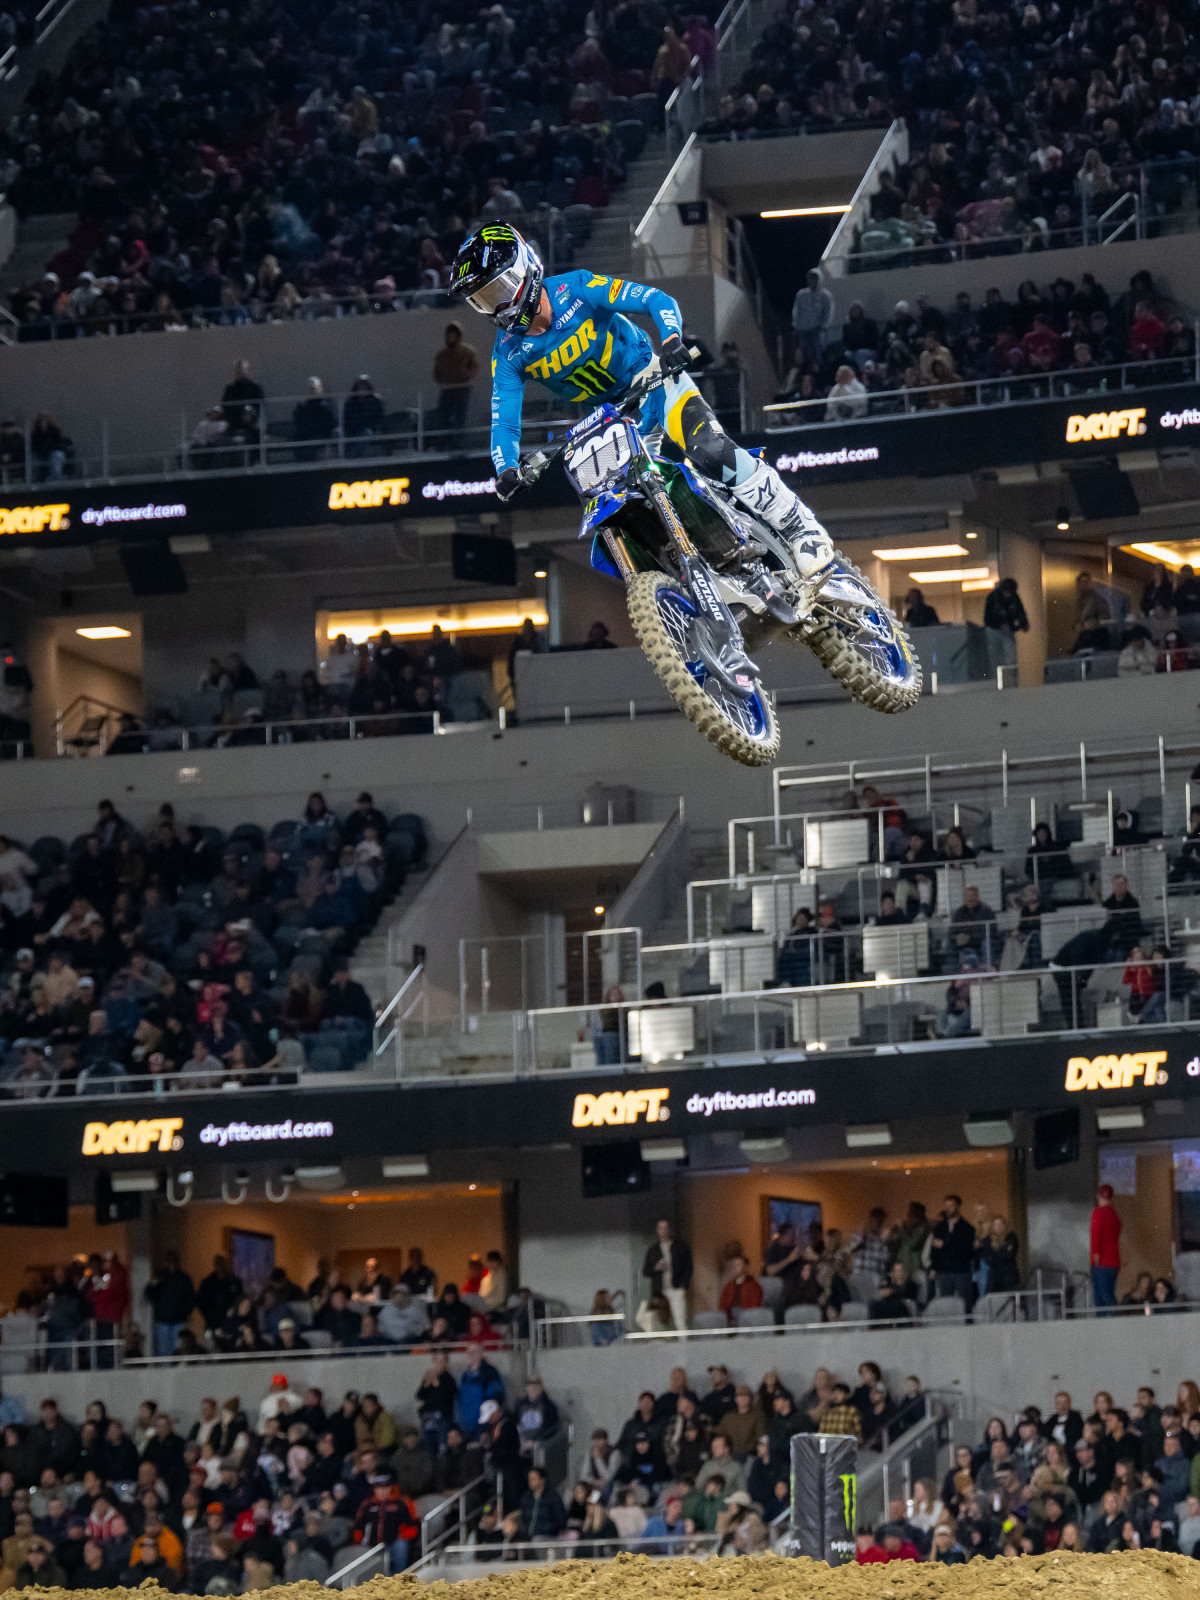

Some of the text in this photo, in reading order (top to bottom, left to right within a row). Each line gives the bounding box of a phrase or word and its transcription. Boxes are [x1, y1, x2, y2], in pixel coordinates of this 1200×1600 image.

[560, 299, 584, 325] YAMAHA
[525, 318, 598, 380] THOR
[569, 423, 631, 492] 100
[776, 447, 879, 473] dryftboard.com
[81, 504, 187, 526] dryftboard.com
[693, 569, 724, 621] DUNLOP
[686, 1088, 816, 1116] dryftboard.com
[199, 1120, 334, 1147] dryftboard.com
